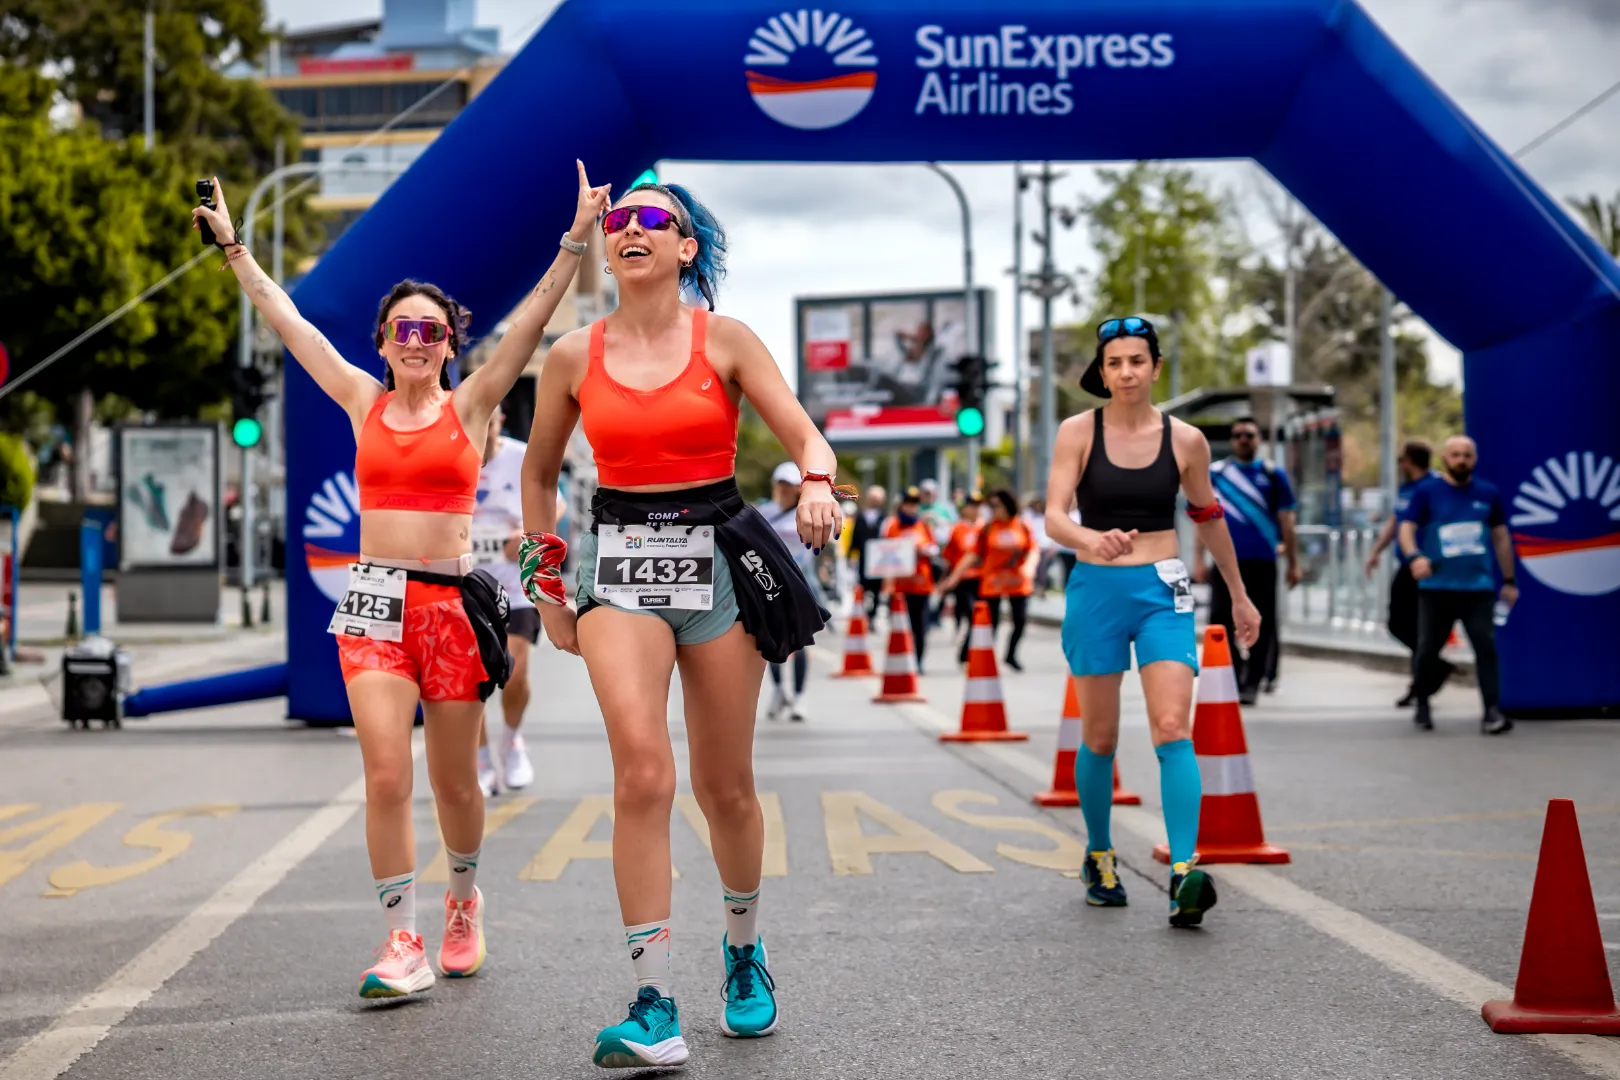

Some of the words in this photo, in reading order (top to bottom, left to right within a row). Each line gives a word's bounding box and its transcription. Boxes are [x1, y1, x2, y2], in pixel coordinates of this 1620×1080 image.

[915, 25, 1175, 78] SunExpress
[915, 72, 1074, 115] Airlines
[647, 512, 680, 520] COMP
[625, 535, 642, 549] 20
[616, 558, 698, 583] 1432
